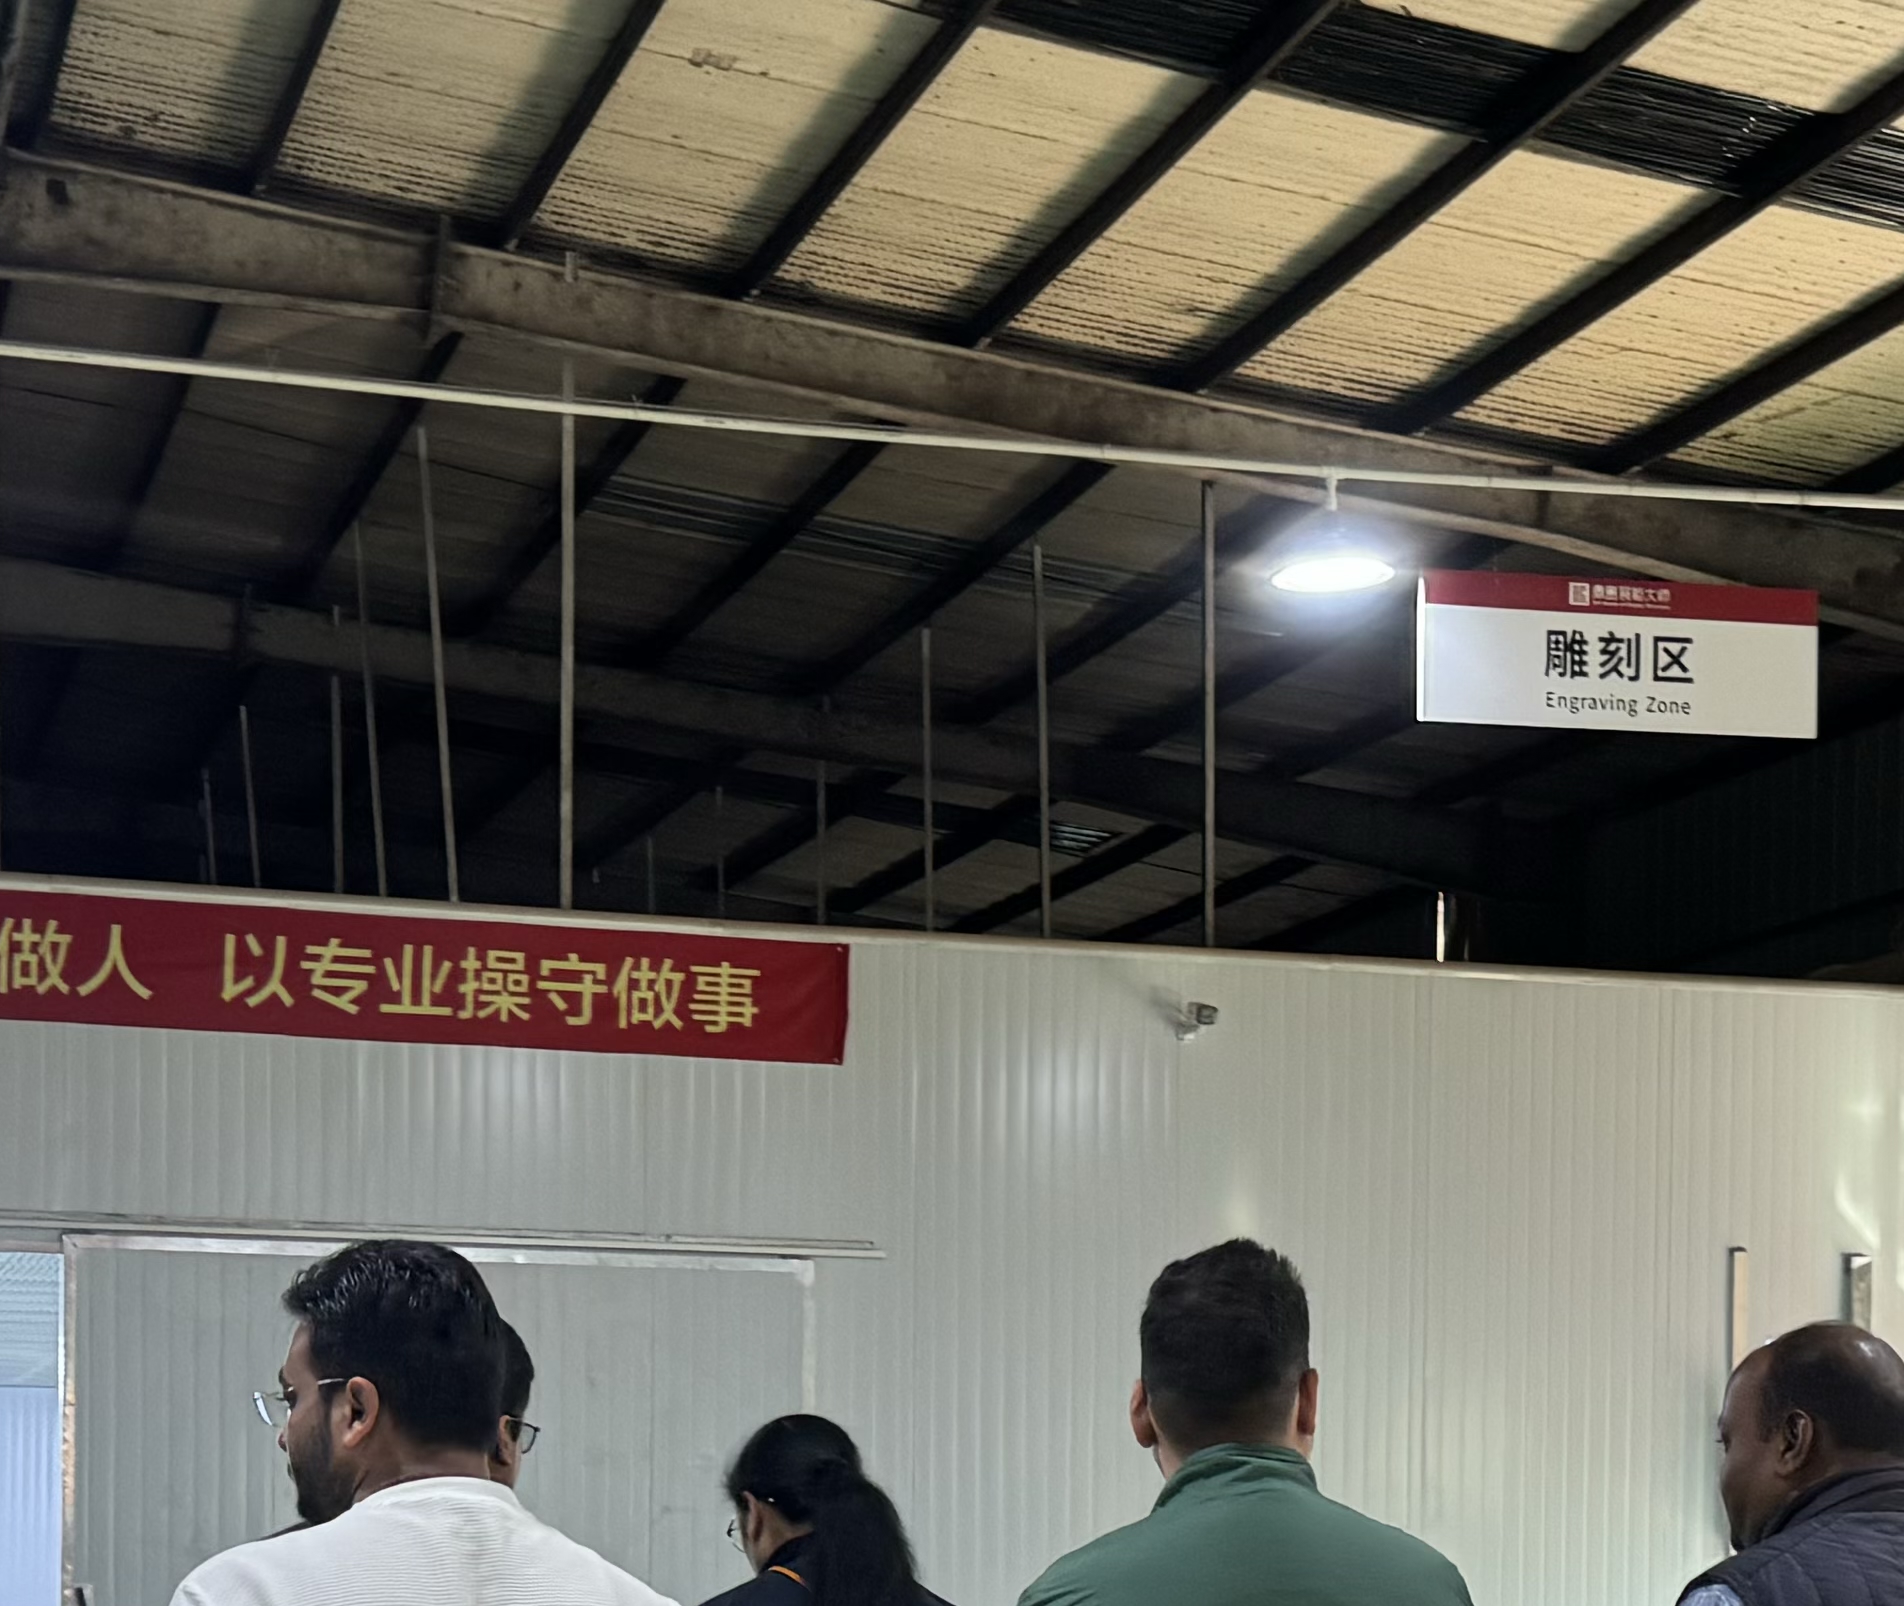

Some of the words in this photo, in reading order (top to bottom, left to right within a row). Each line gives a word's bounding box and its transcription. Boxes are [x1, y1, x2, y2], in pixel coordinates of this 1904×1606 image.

[1544, 629, 1695, 684] 雕刻区
[1545, 691, 1639, 718] Engraving
[1645, 695, 1692, 715] Zone
[219, 932, 762, 1034] 以专业操守做事
